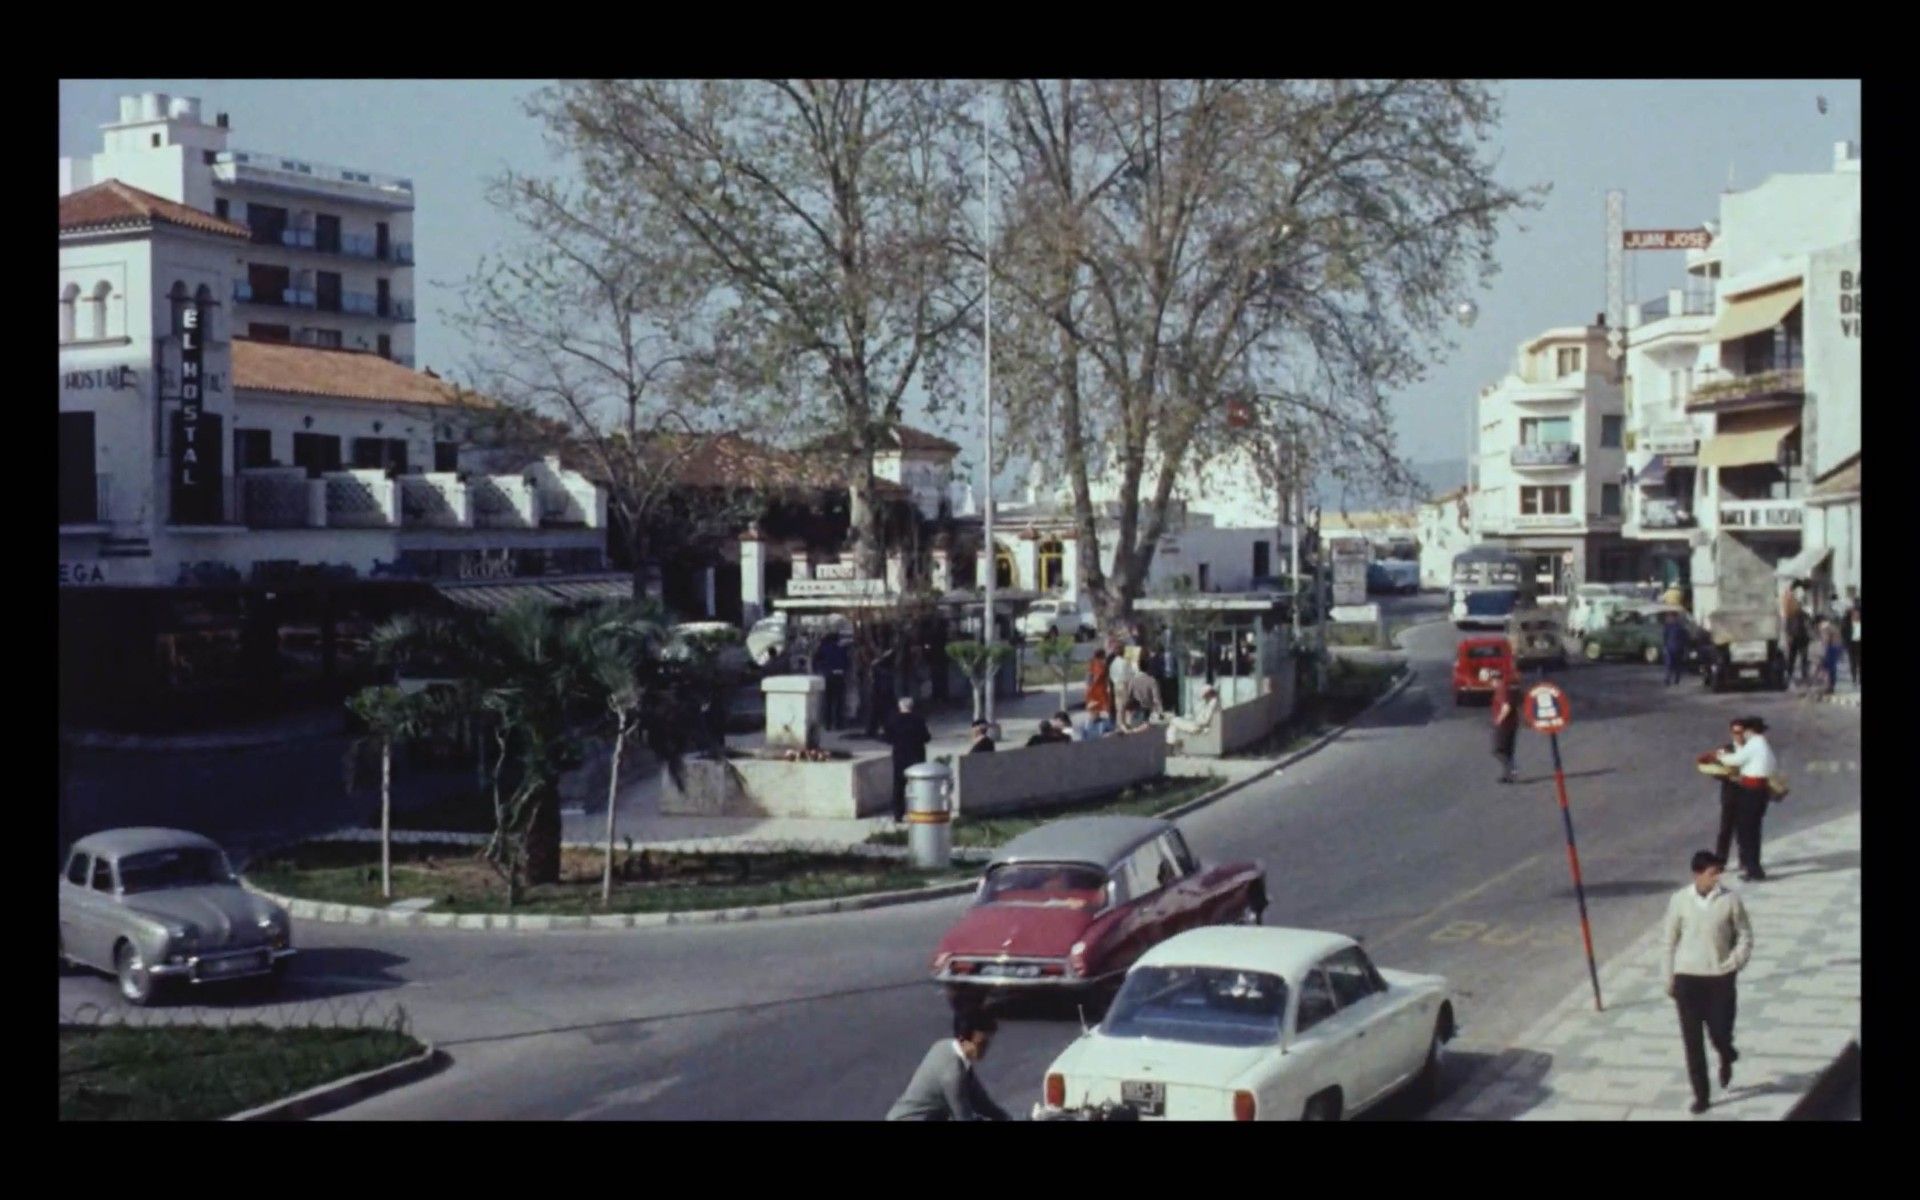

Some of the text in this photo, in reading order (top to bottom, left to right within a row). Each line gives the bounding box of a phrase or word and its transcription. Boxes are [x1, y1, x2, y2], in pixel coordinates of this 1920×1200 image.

[1624, 231, 1664, 248] JUAN
[183, 308, 198, 485] EL HOSTAL
